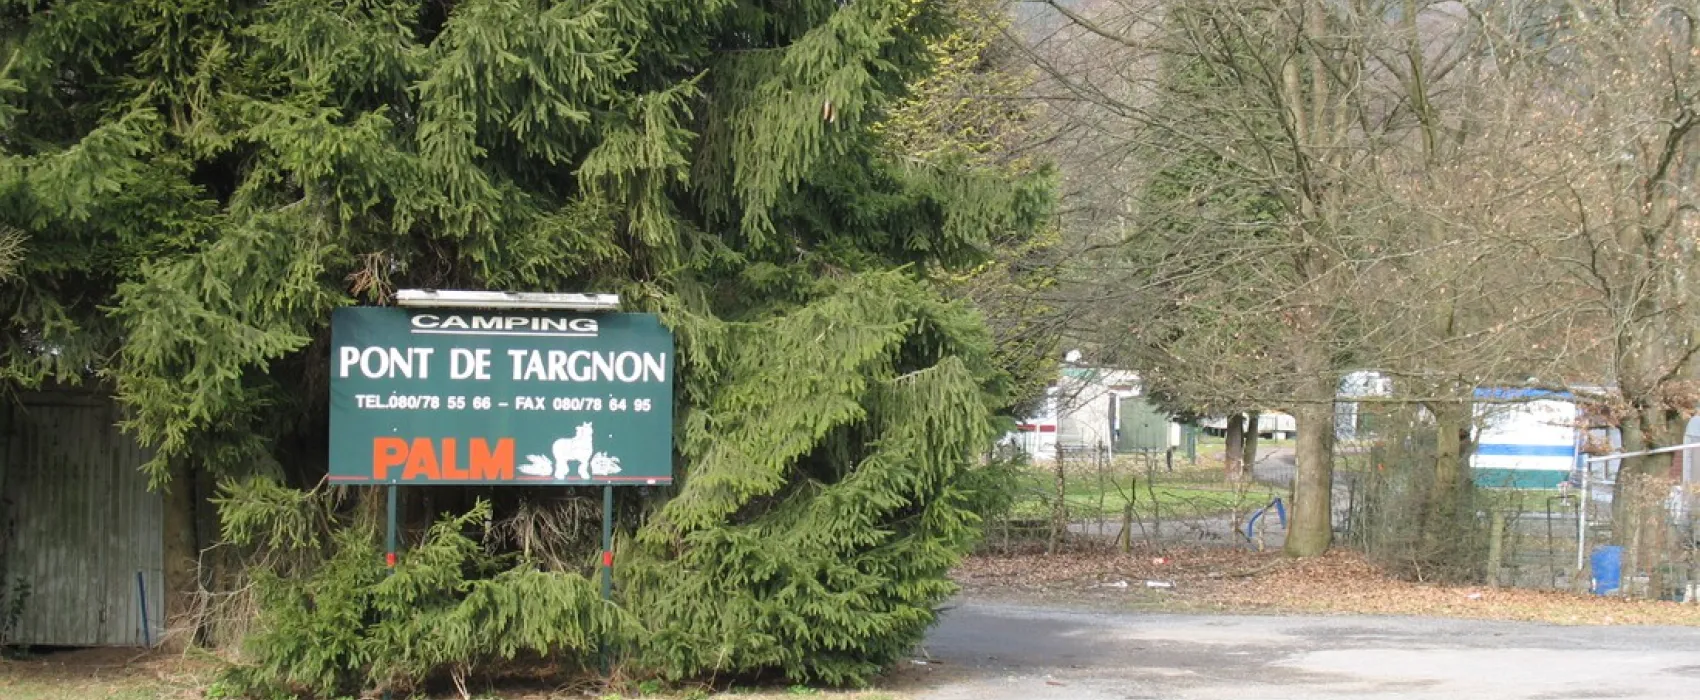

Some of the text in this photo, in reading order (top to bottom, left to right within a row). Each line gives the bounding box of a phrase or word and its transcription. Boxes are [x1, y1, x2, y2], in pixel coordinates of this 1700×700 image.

[411, 314, 598, 332] CAMPING
[340, 346, 666, 383] PONT DE TARGNON
[447, 396, 466, 410] 55
[472, 396, 492, 410] 66
[515, 396, 546, 411] FAX
[552, 397, 602, 412] 080/78
[633, 398, 652, 412] 95
[373, 437, 515, 480] PALM
